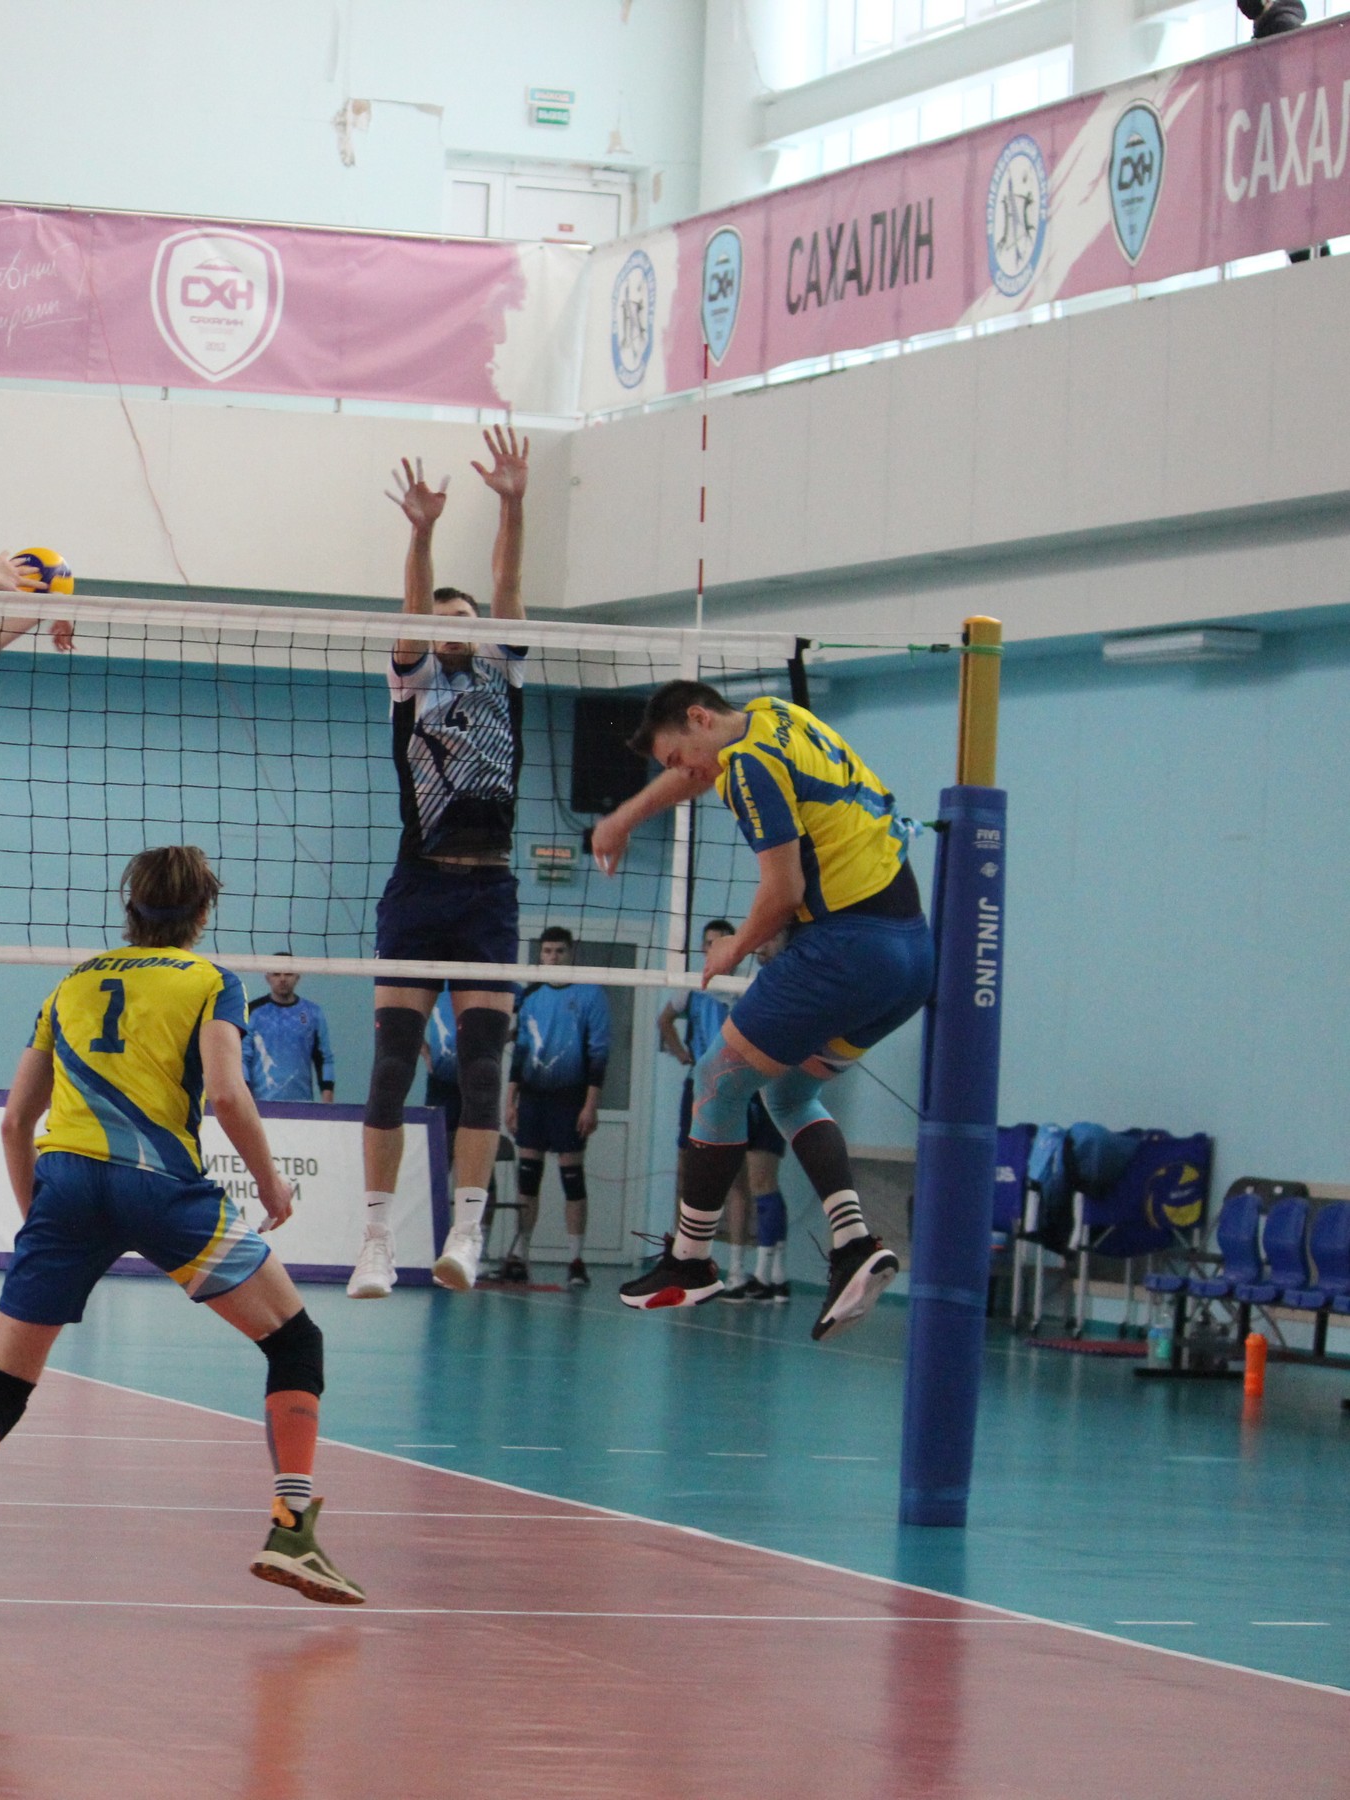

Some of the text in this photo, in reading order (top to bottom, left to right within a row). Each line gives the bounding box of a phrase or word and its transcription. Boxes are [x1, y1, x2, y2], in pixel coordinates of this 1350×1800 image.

[786, 197, 934, 315] САХАЛИН
[445, 692, 469, 732] 4
[974, 897, 999, 1008] JINLING
[89, 978, 125, 1053] 1
